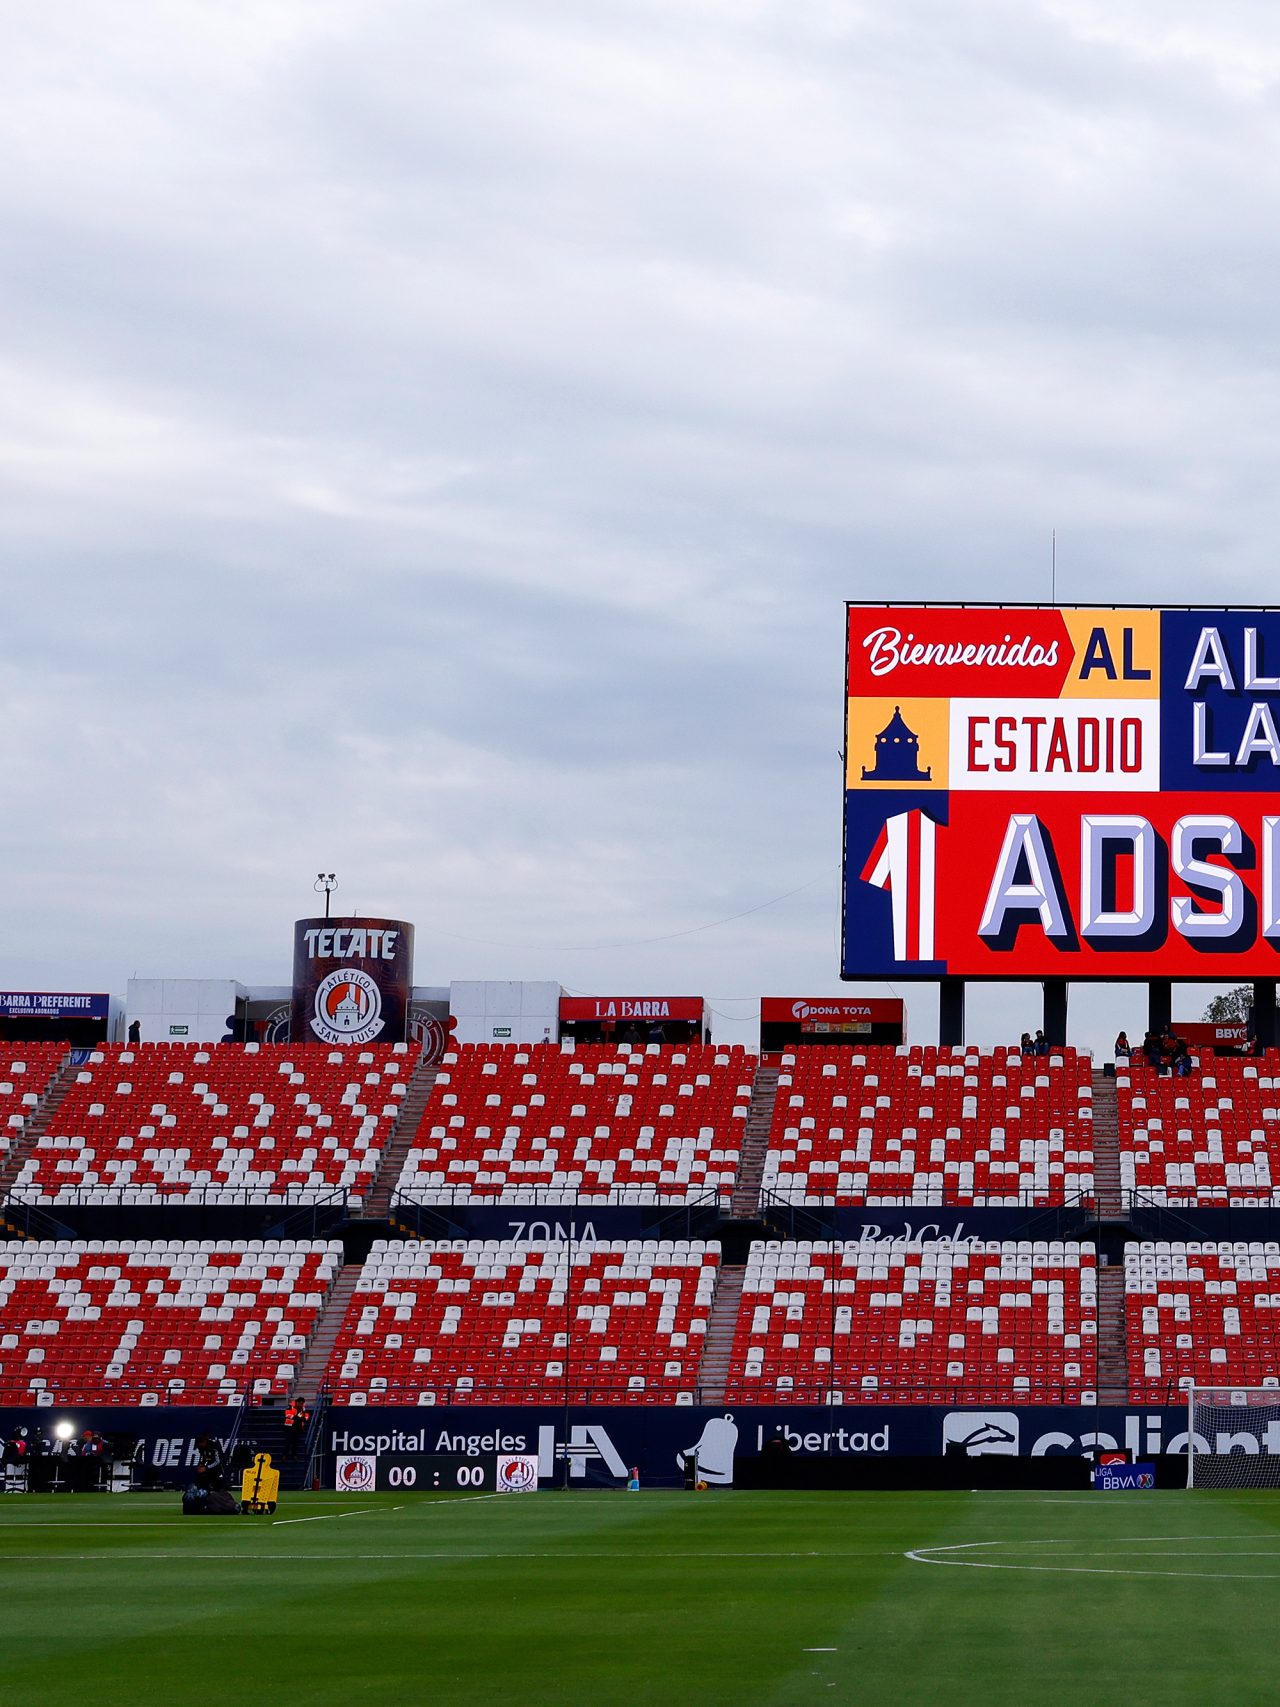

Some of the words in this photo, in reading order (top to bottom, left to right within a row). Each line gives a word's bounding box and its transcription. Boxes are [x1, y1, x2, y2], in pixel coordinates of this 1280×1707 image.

[862, 626, 1059, 676] Bienvenidos
[1079, 627, 1151, 680] AL
[967, 716, 1143, 773] ESTADIO
[303, 928, 398, 960] TECATE
[327, 971, 371, 990] ATLÉTICO
[33, 995, 92, 1008] PREFERENTE
[595, 1001, 617, 1017] LA
[621, 1001, 670, 1017] BARRA
[843, 1006, 872, 1015] TOTA
[318, 1026, 340, 1044] SAN
[332, 1429, 425, 1456] Hospital
[436, 1430, 526, 1456] Angeles
[388, 1466, 416, 1486] 00
[456, 1466, 485, 1486] 00
[1095, 1467, 1113, 1477] LIGA
[1103, 1475, 1136, 1490] BBVA
